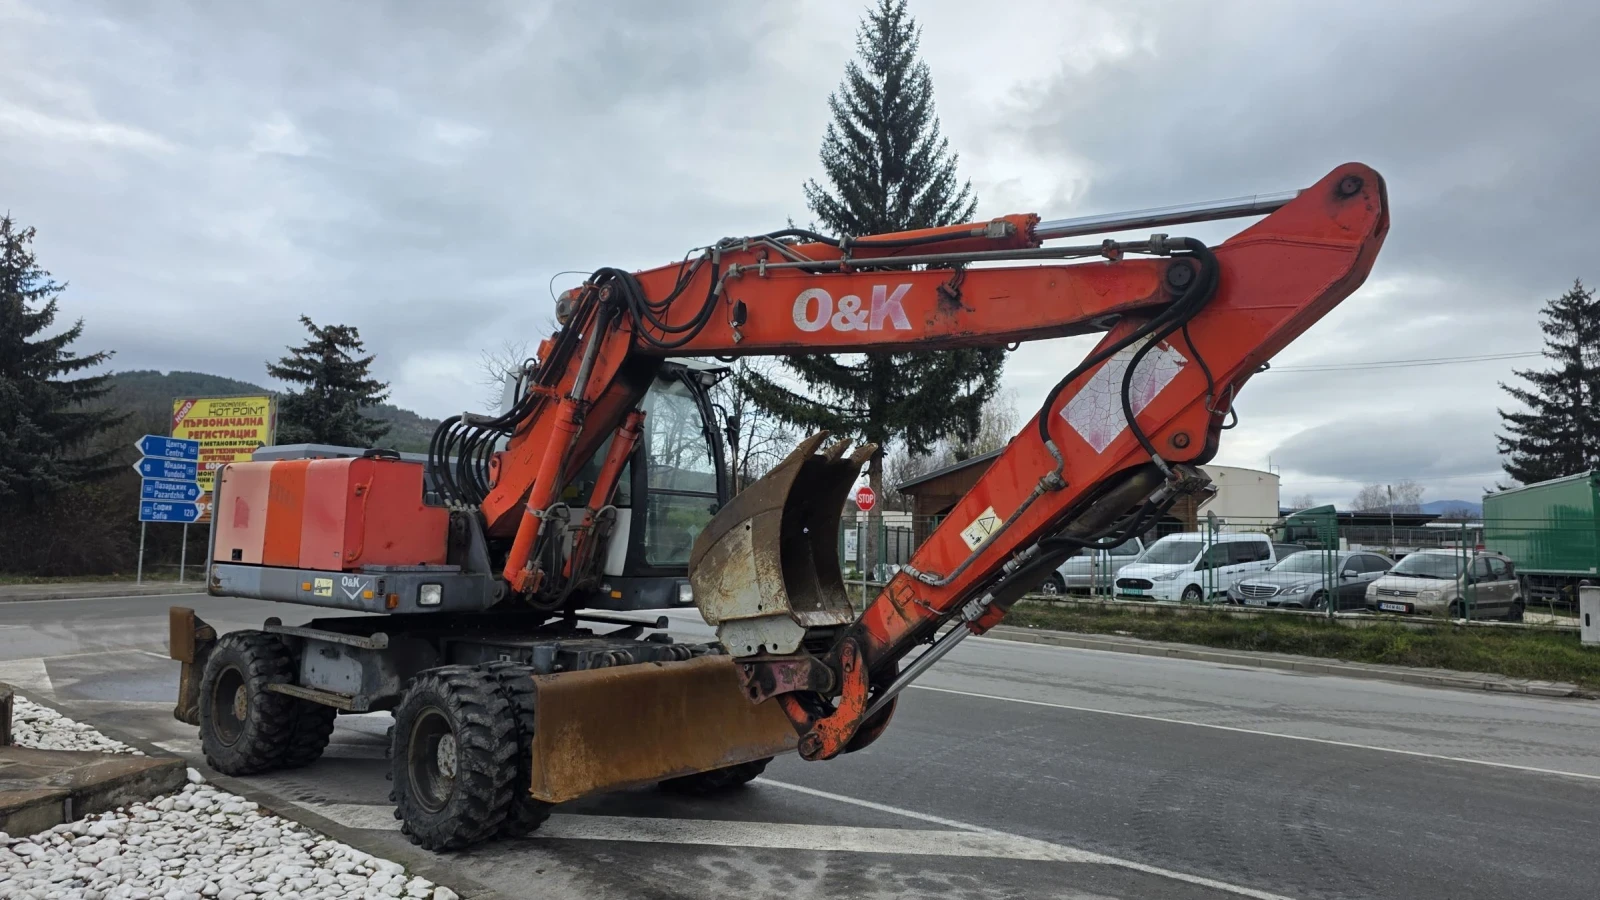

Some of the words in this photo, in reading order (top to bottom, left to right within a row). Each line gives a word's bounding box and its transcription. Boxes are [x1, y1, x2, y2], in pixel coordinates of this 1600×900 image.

[792, 283, 914, 332] O&K
[175, 401, 192, 423] НОВО
[208, 408, 230, 416] HOT
[232, 406, 265, 416] POINT
[183, 417, 264, 428] ПЪРВОНАЧАЛНА
[188, 429, 258, 440] РЕГИСТРАЦИЯ
[166, 440, 187, 450] Център
[165, 448, 184, 457] Centre
[164, 460, 186, 470] Юндола
[164, 470, 186, 478] Yundola
[154, 481, 187, 491] Пазарджик
[154, 490, 185, 499] Pazardzhik
[858, 494, 874, 504] STOP
[152, 502, 172, 511] София
[152, 512, 168, 520] Sofia
[184, 509, 194, 517] 120
[341, 576, 360, 588] O&K
